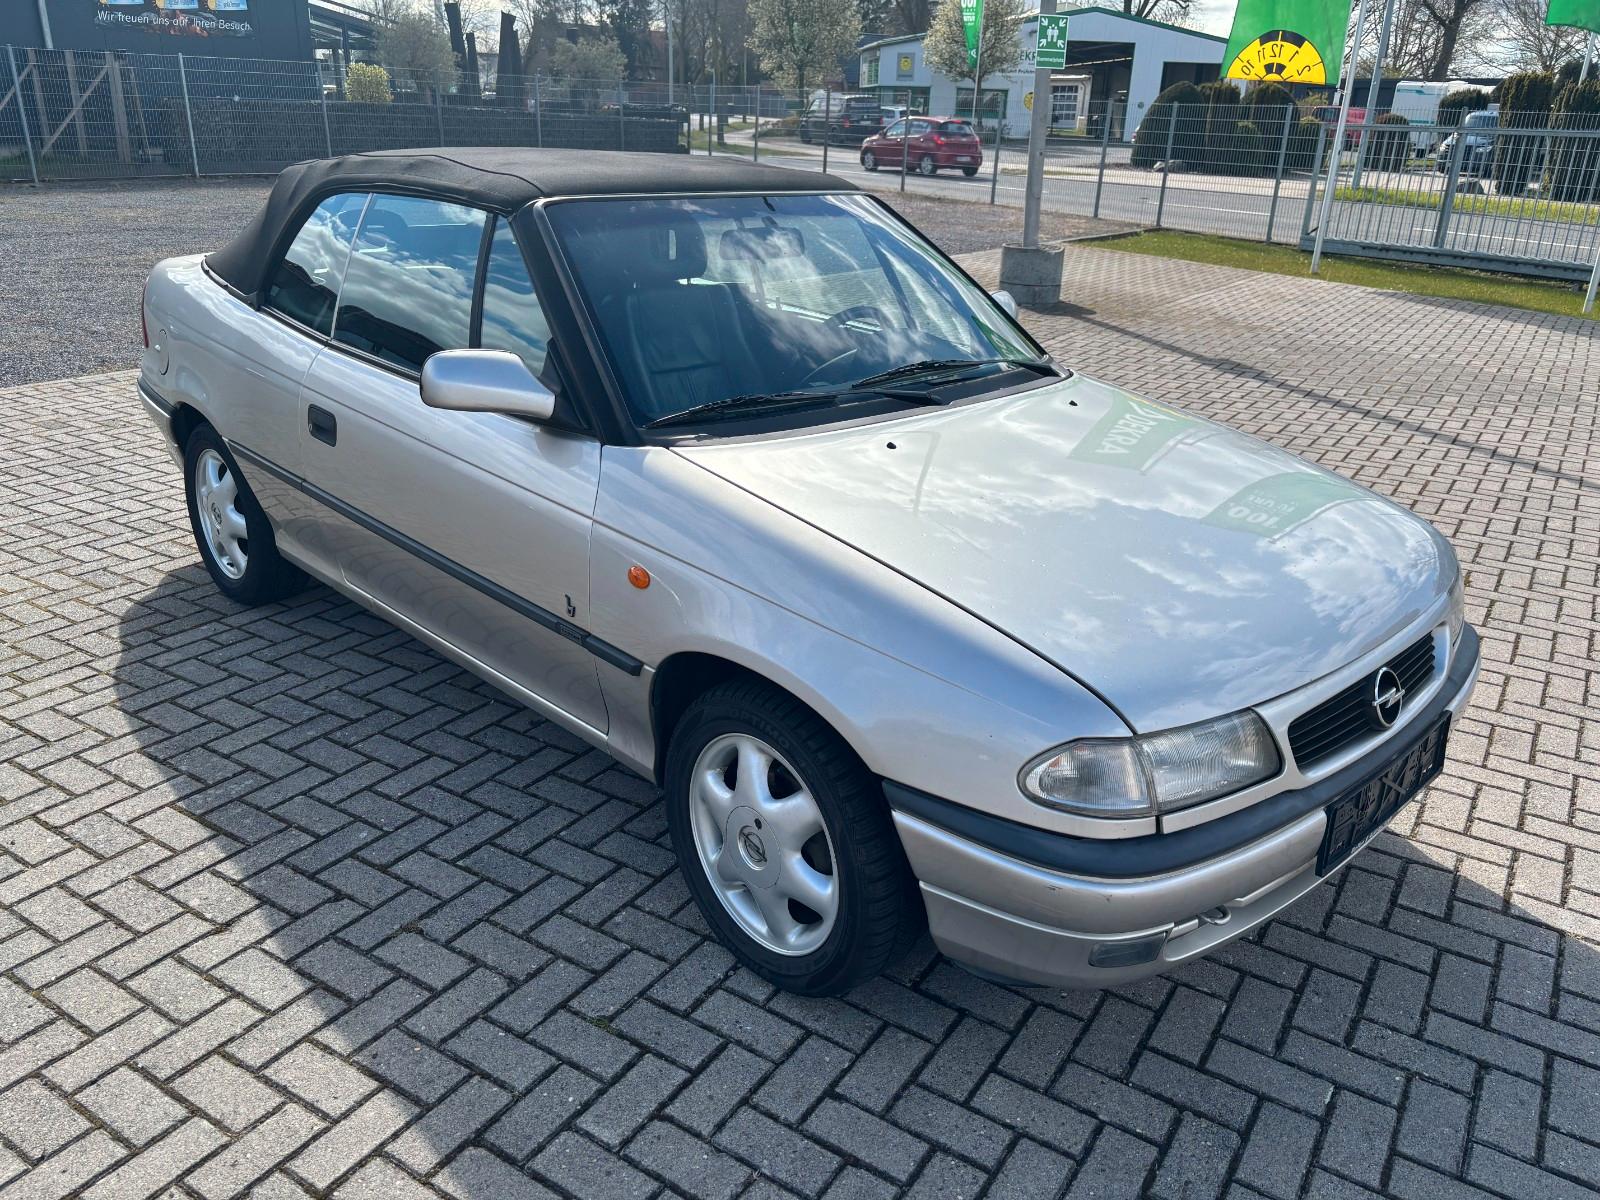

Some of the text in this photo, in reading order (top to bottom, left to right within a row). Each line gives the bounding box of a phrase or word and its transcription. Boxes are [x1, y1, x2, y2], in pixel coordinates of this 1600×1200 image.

[97, 10, 251, 31] Wir freuen uns auf Ihren Besuch
[1095, 415, 1158, 455] DEKRA
